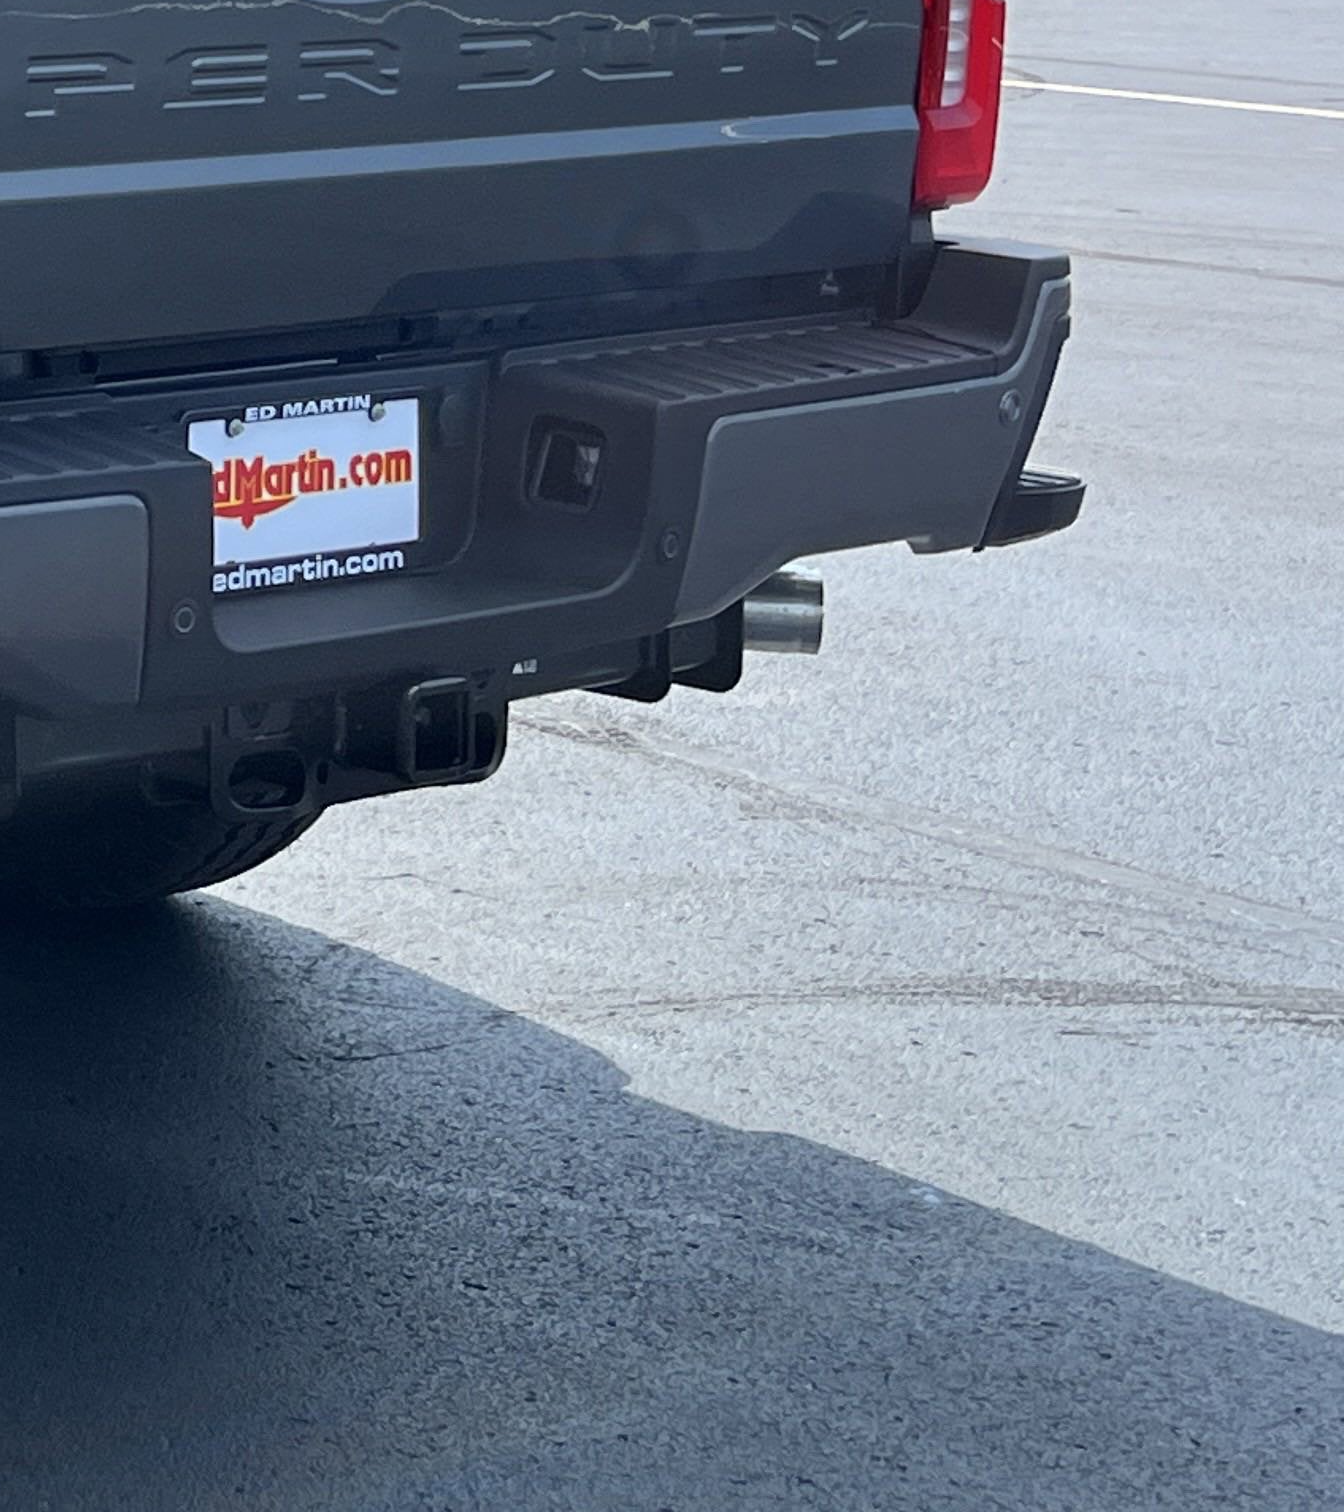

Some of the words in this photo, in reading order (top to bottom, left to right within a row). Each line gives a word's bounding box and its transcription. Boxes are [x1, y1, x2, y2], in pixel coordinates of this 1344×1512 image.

[457, 9, 869, 90] DUTY
[245, 406, 277, 422] ED
[282, 394, 372, 418] MARTIN
[213, 449, 412, 504] dMartin.com
[213, 549, 404, 593] edmartin.com
